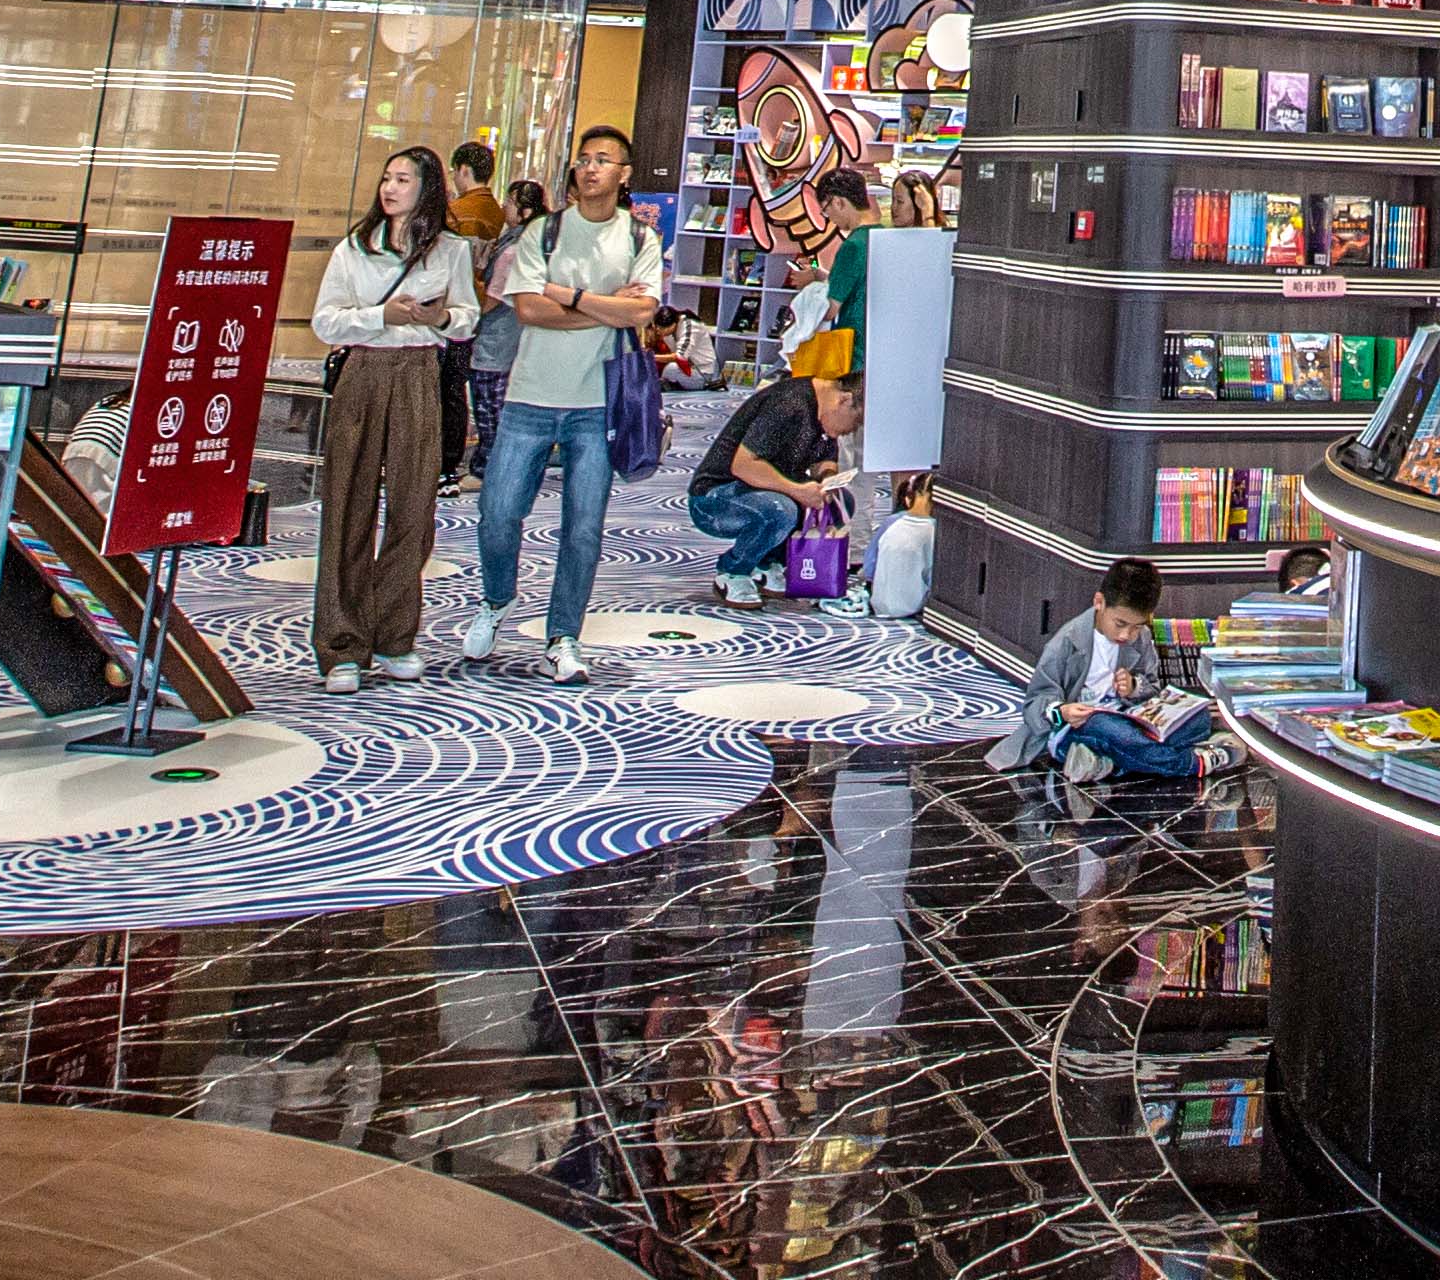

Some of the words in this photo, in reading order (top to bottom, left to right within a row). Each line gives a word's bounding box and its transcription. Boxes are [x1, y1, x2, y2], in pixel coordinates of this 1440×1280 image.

[199, 239, 255, 261] 温馨提示
[175, 270, 270, 286] 为营造良好的阅读环境
